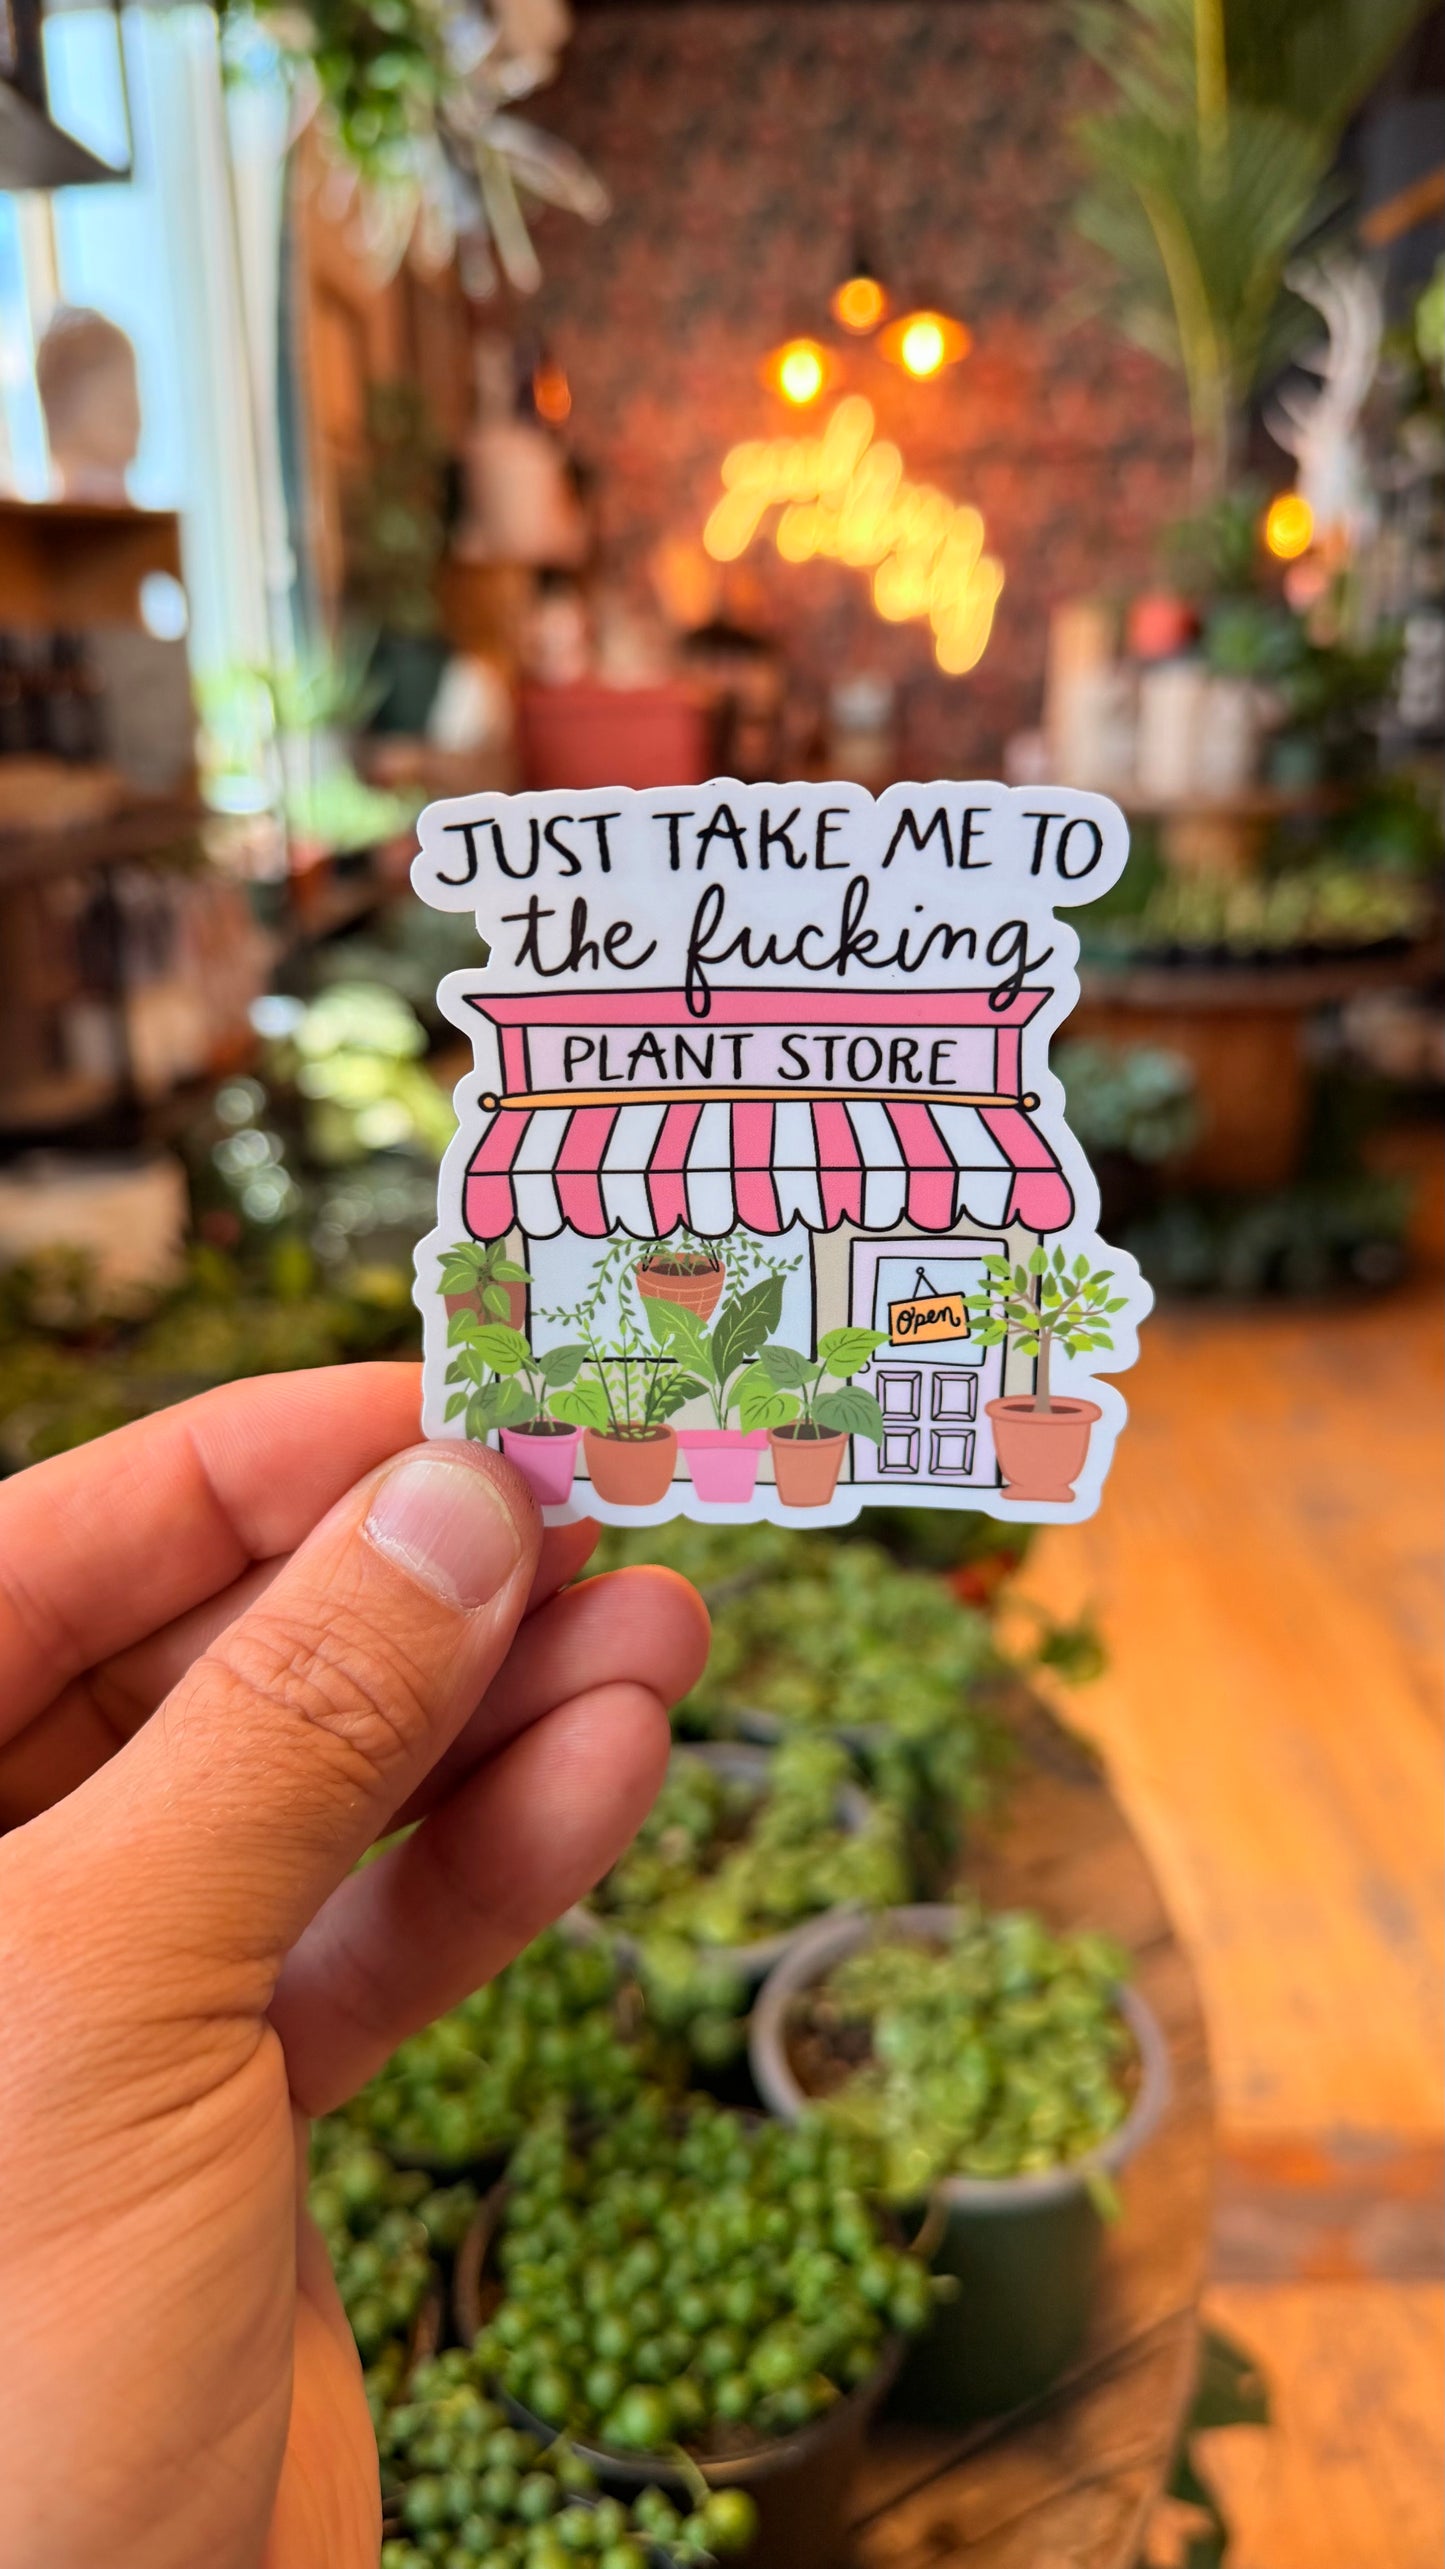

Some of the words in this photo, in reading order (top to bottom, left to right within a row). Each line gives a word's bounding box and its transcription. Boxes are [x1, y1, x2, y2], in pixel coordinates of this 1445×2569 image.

[436, 812, 622, 886] JUST
[651, 803, 851, 871] TAKE
[881, 807, 992, 870] ME
[1022, 812, 1104, 880] TO
[501, 894, 658, 978] the
[685, 875, 1055, 1018] fucking
[563, 1031, 754, 1083] PLANT
[777, 1033, 958, 1086] STORE
[896, 1303, 961, 1335] Open
